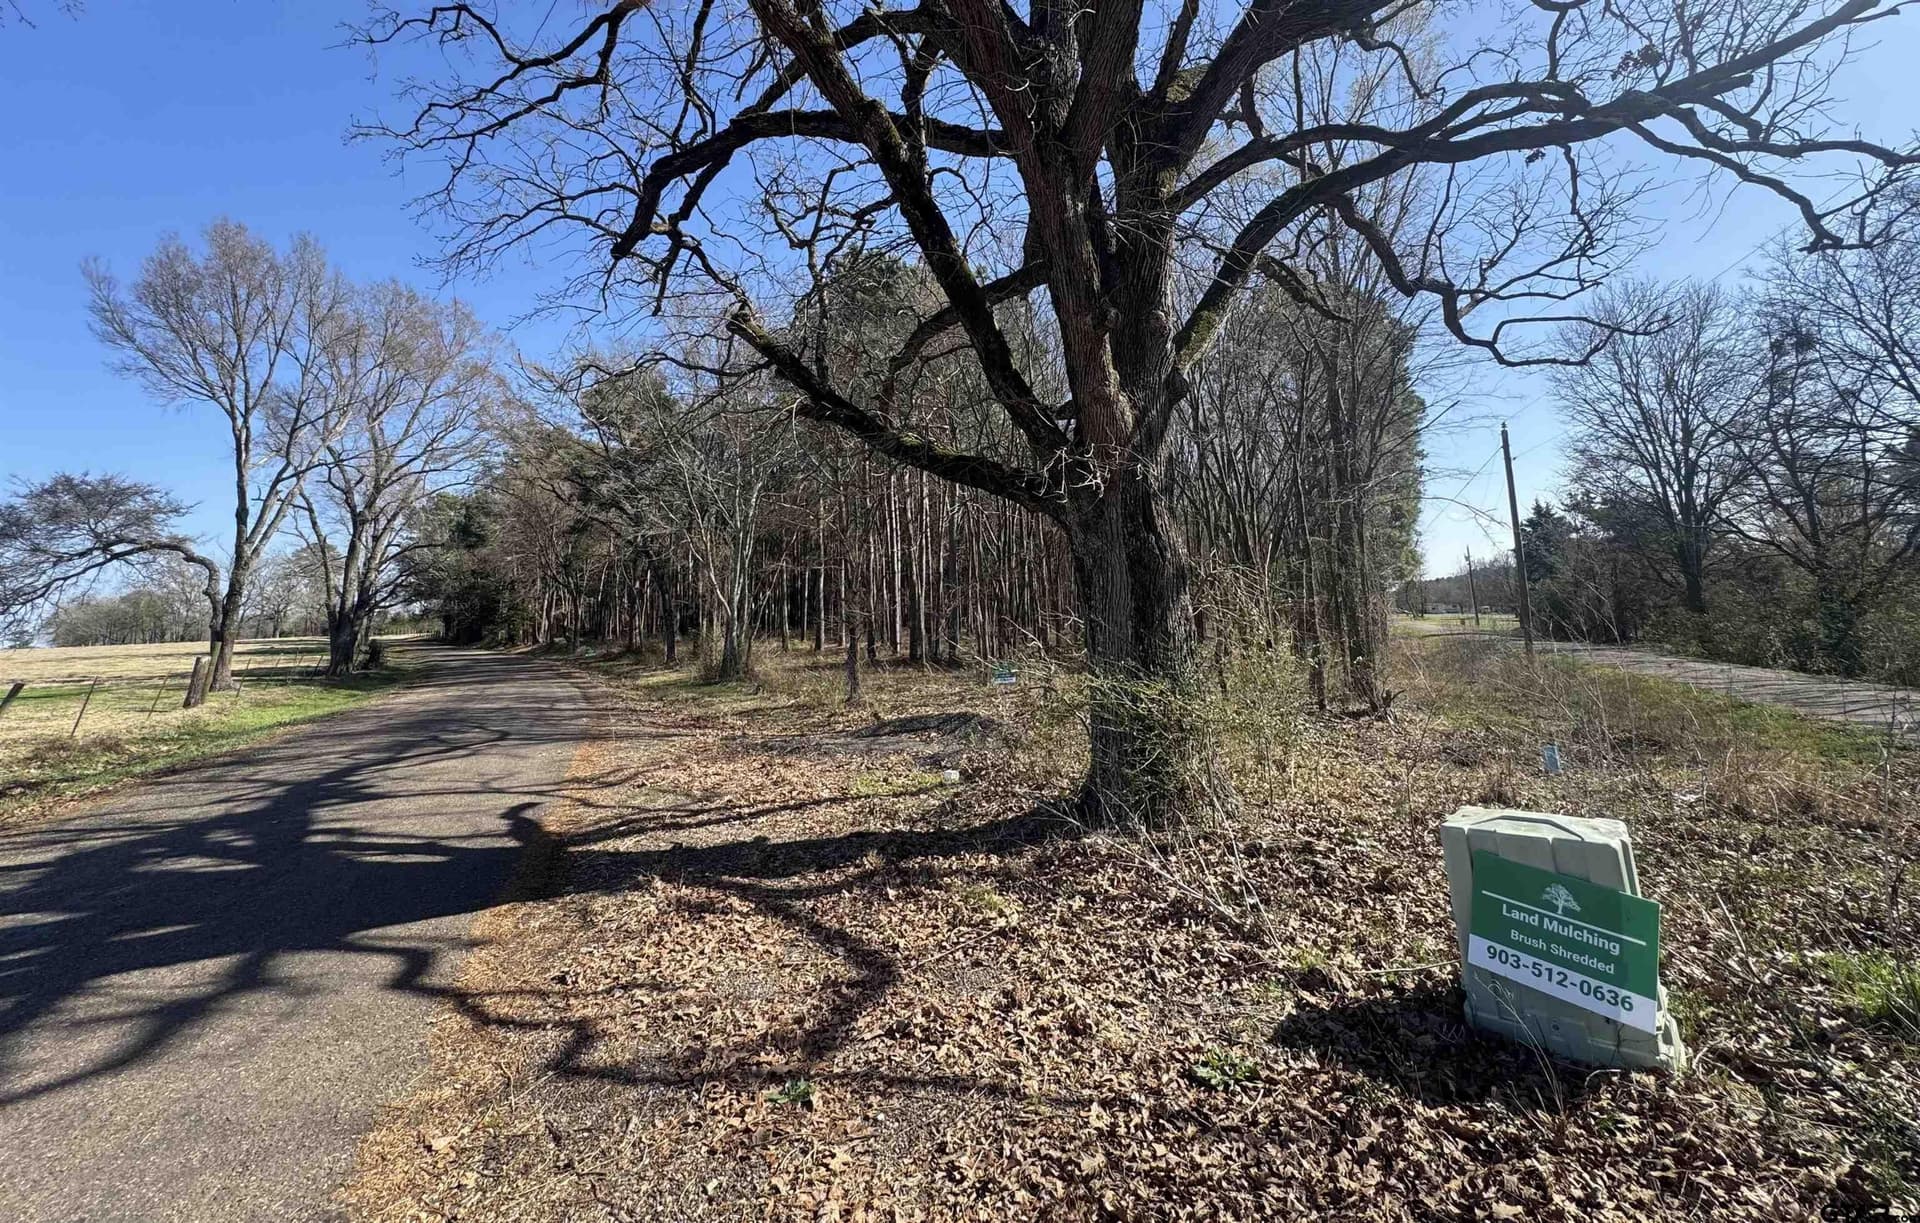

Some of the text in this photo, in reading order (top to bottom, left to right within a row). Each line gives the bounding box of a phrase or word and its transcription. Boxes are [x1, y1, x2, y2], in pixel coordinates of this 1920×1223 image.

[1502, 904, 1620, 955] Land Mulching
[1510, 929, 1615, 975] Brush Shredded
[1486, 945, 1634, 1012] 903-512-0636
